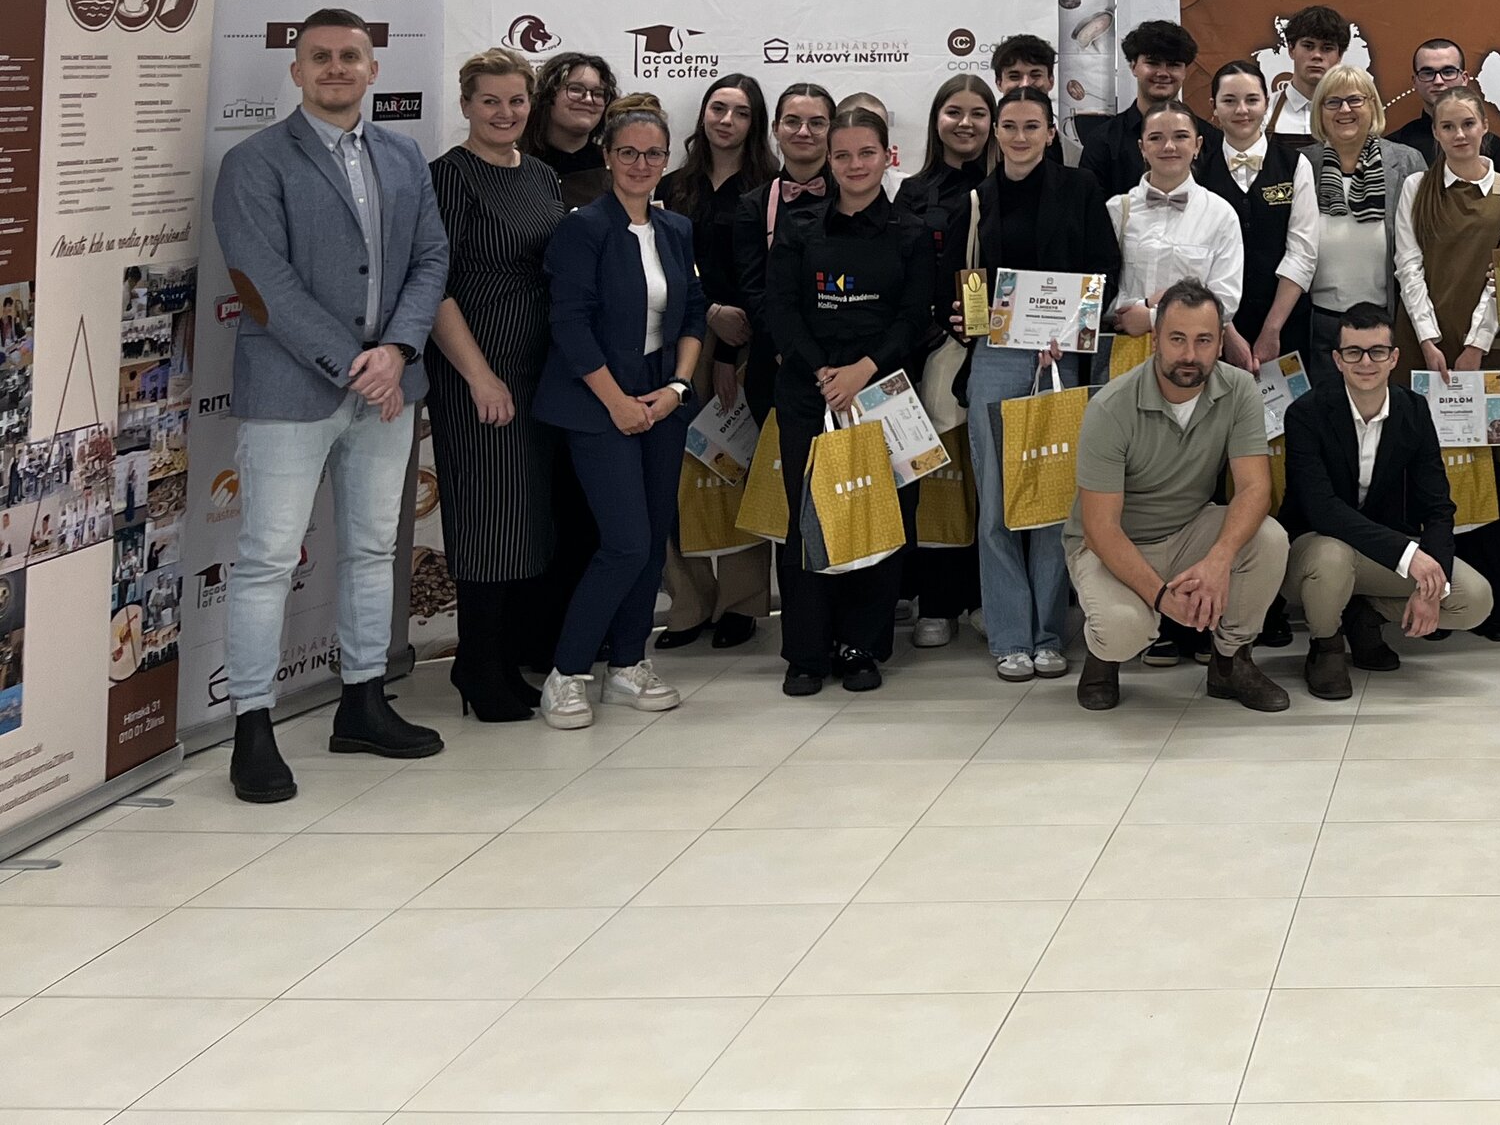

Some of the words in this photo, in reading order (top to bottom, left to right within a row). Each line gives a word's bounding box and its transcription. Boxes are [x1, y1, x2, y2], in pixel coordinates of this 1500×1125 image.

[796, 40, 909, 52] MEDZINÁRODNÝ
[642, 52, 719, 67] academy
[796, 50, 850, 64] KÁVOVÝ
[854, 49, 909, 64] INŠTITÚT
[643, 66, 660, 79] of
[667, 66, 719, 79] coffee
[1029, 297, 1066, 306] DIPLOM
[719, 402, 747, 434] DIPLOM
